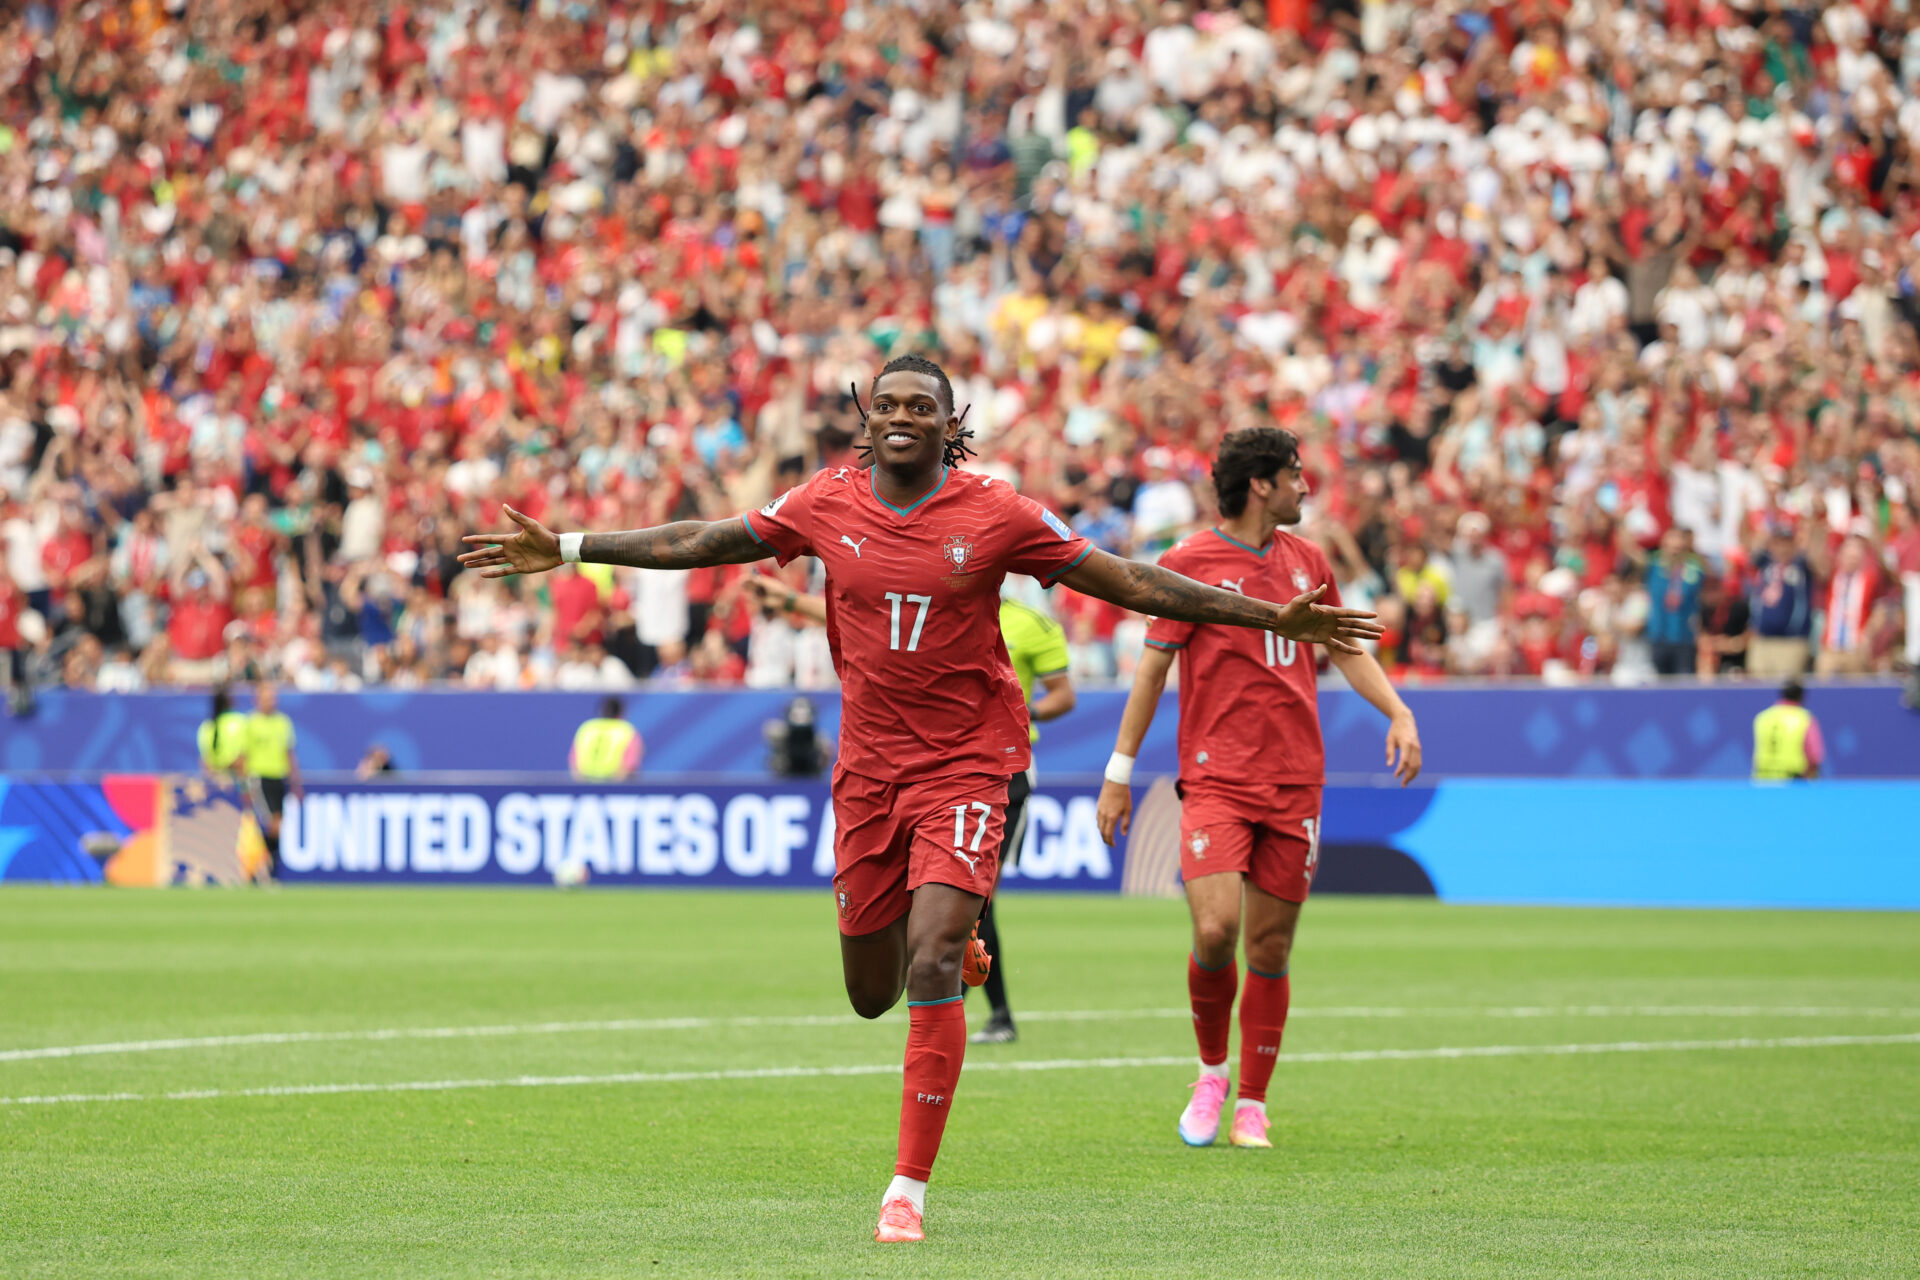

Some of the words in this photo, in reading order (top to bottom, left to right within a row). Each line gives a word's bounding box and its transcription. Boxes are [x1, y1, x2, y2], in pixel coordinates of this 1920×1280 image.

[885, 592, 932, 651] 17
[279, 793, 490, 872] UNITED
[495, 792, 719, 875] STATES
[722, 793, 811, 877] OF
[949, 801, 992, 852] 17
